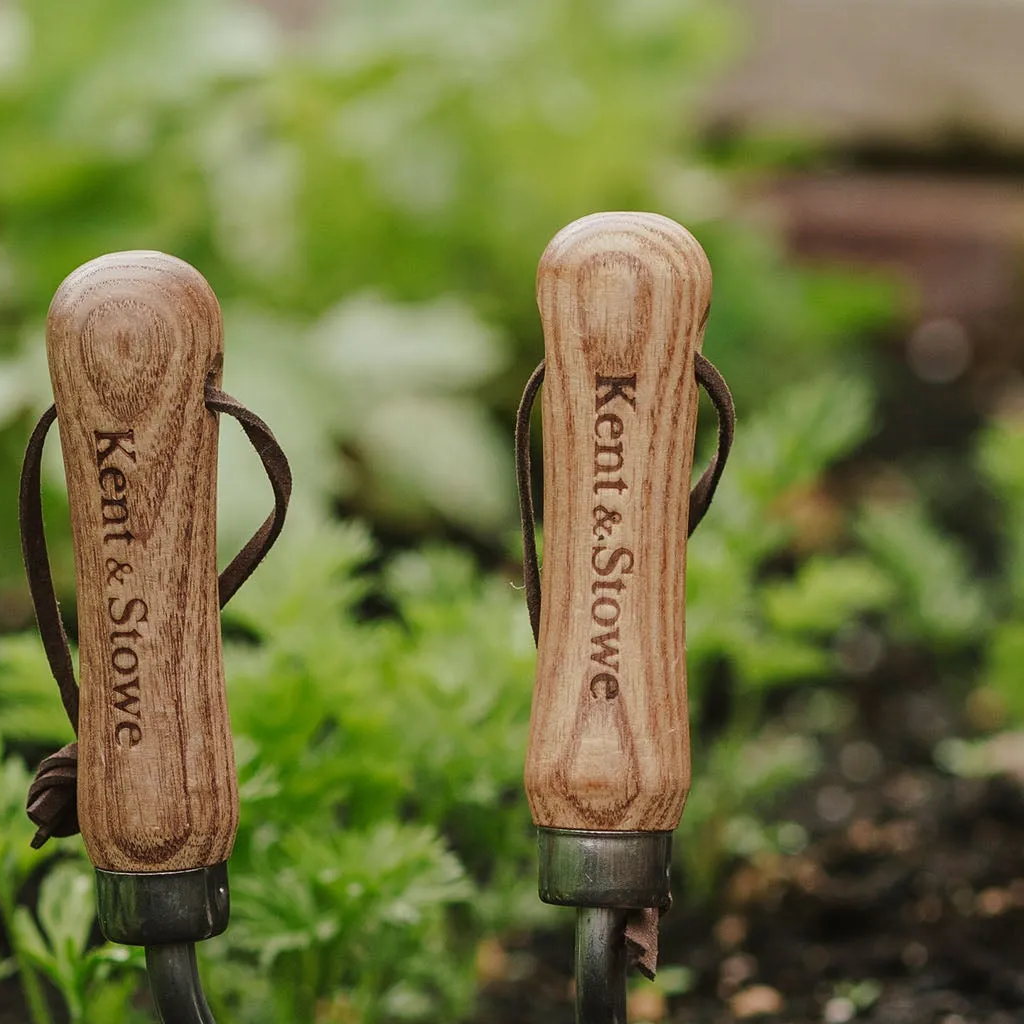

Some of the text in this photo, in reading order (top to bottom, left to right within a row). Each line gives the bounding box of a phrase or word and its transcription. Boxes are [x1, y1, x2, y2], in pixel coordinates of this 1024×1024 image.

[94, 428, 149, 750] Kent & Stowe
[589, 372, 637, 702] Kent & Stowe
